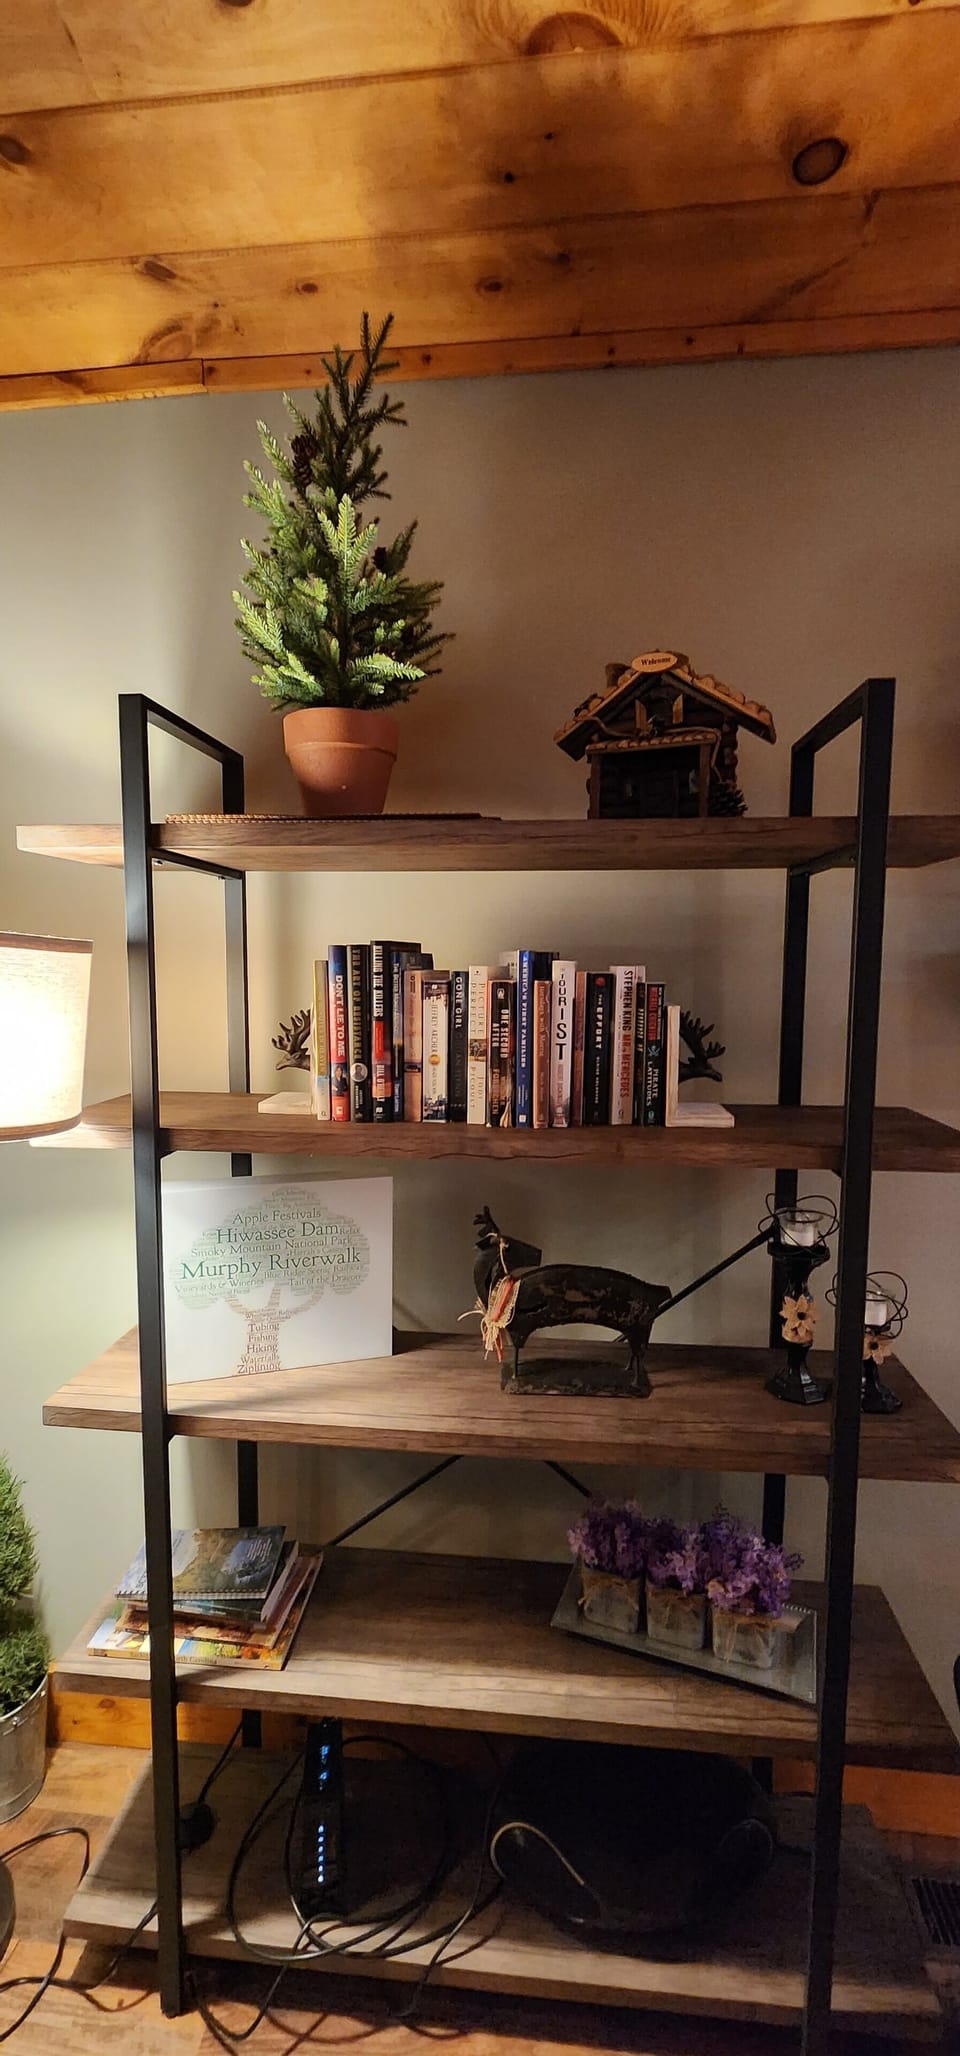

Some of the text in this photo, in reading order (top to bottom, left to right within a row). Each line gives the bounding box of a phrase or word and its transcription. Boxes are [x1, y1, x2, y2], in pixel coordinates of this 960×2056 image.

[641, 657, 671, 666] Welcome
[373, 945, 383, 973] KILLING
[374, 974, 384, 988] THE
[455, 976, 463, 1004] GONE
[352, 949, 362, 1059] THE ART OF RESISTANCE
[374, 990, 384, 1017] KILLERS
[622, 970, 633, 1031] STEPHEN KING
[335, 975, 346, 1056] DON'T LIE TO ME
[555, 974, 566, 1060] TOURIST
[431, 1004, 439, 1053] JEFFREY ARCHER
[492, 1022, 500, 1047] AFTER
[500, 1009, 509, 1058] ONE SECOND
[376, 1064, 384, 1078] BILL
[620, 1054, 631, 1098] MERCEDES
[232, 1212, 268, 1227] Apple
[272, 1208, 321, 1222] Festivals
[216, 1228, 295, 1244] Hiwassee
[301, 1222, 338, 1236] Dam
[339, 1226, 360, 1235] Relax
[191, 1236, 351, 1257] Smoky Mountain National Park
[181, 1247, 360, 1280] Murphy Riverwalk
[229, 1279, 264, 1288] Wineries
[264, 1271, 280, 1279] Blue
[289, 1278, 304, 1286] Tail
[332, 1274, 360, 1282] Dragon
[248, 1323, 279, 1332] Tubing
[248, 1333, 278, 1343] Fishing
[240, 1353, 279, 1363] Waterfalls
[247, 1343, 278, 1354] Hiking
[237, 1360, 281, 1375] Ziplining
